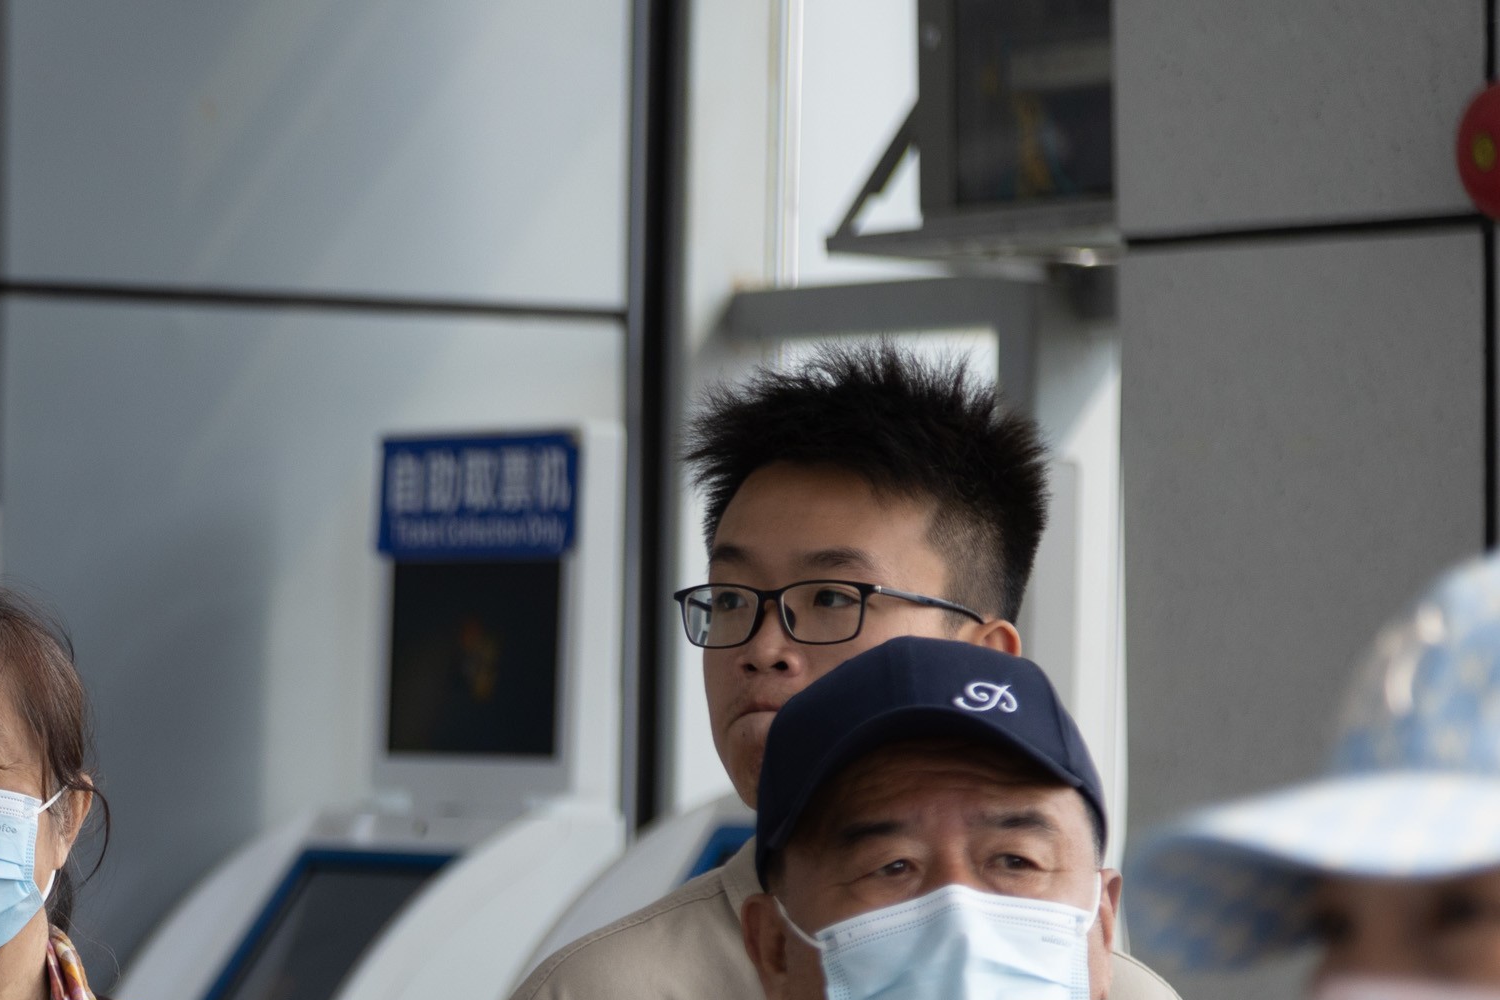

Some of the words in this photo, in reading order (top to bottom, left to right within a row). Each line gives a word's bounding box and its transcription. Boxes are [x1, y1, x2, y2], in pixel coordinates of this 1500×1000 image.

[387, 446, 571, 513] 自助取票机
